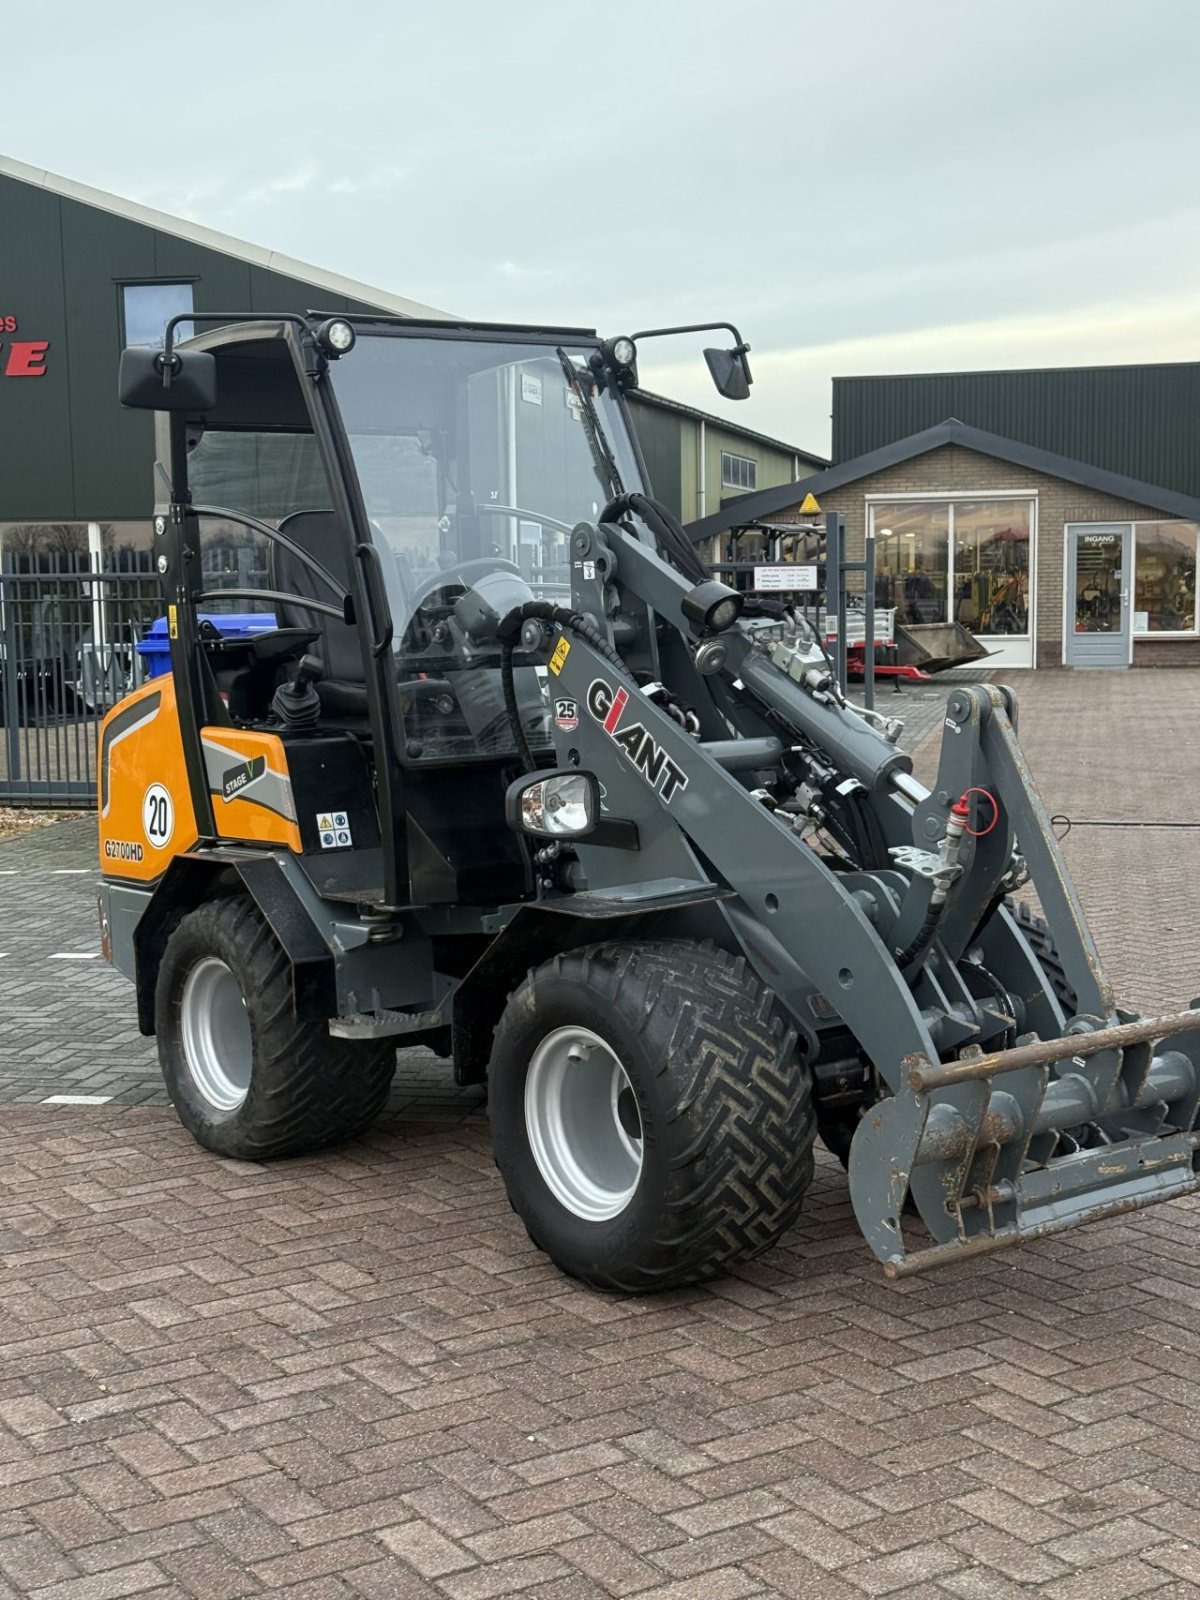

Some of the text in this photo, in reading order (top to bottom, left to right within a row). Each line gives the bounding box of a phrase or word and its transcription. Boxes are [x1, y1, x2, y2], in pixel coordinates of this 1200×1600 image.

[0, 341, 49, 376] E
[558, 702, 575, 719] 25
[587, 678, 689, 804] GIANT
[226, 773, 247, 793] STAGE
[149, 795, 167, 836] 20
[105, 840, 143, 861] G2700HD
